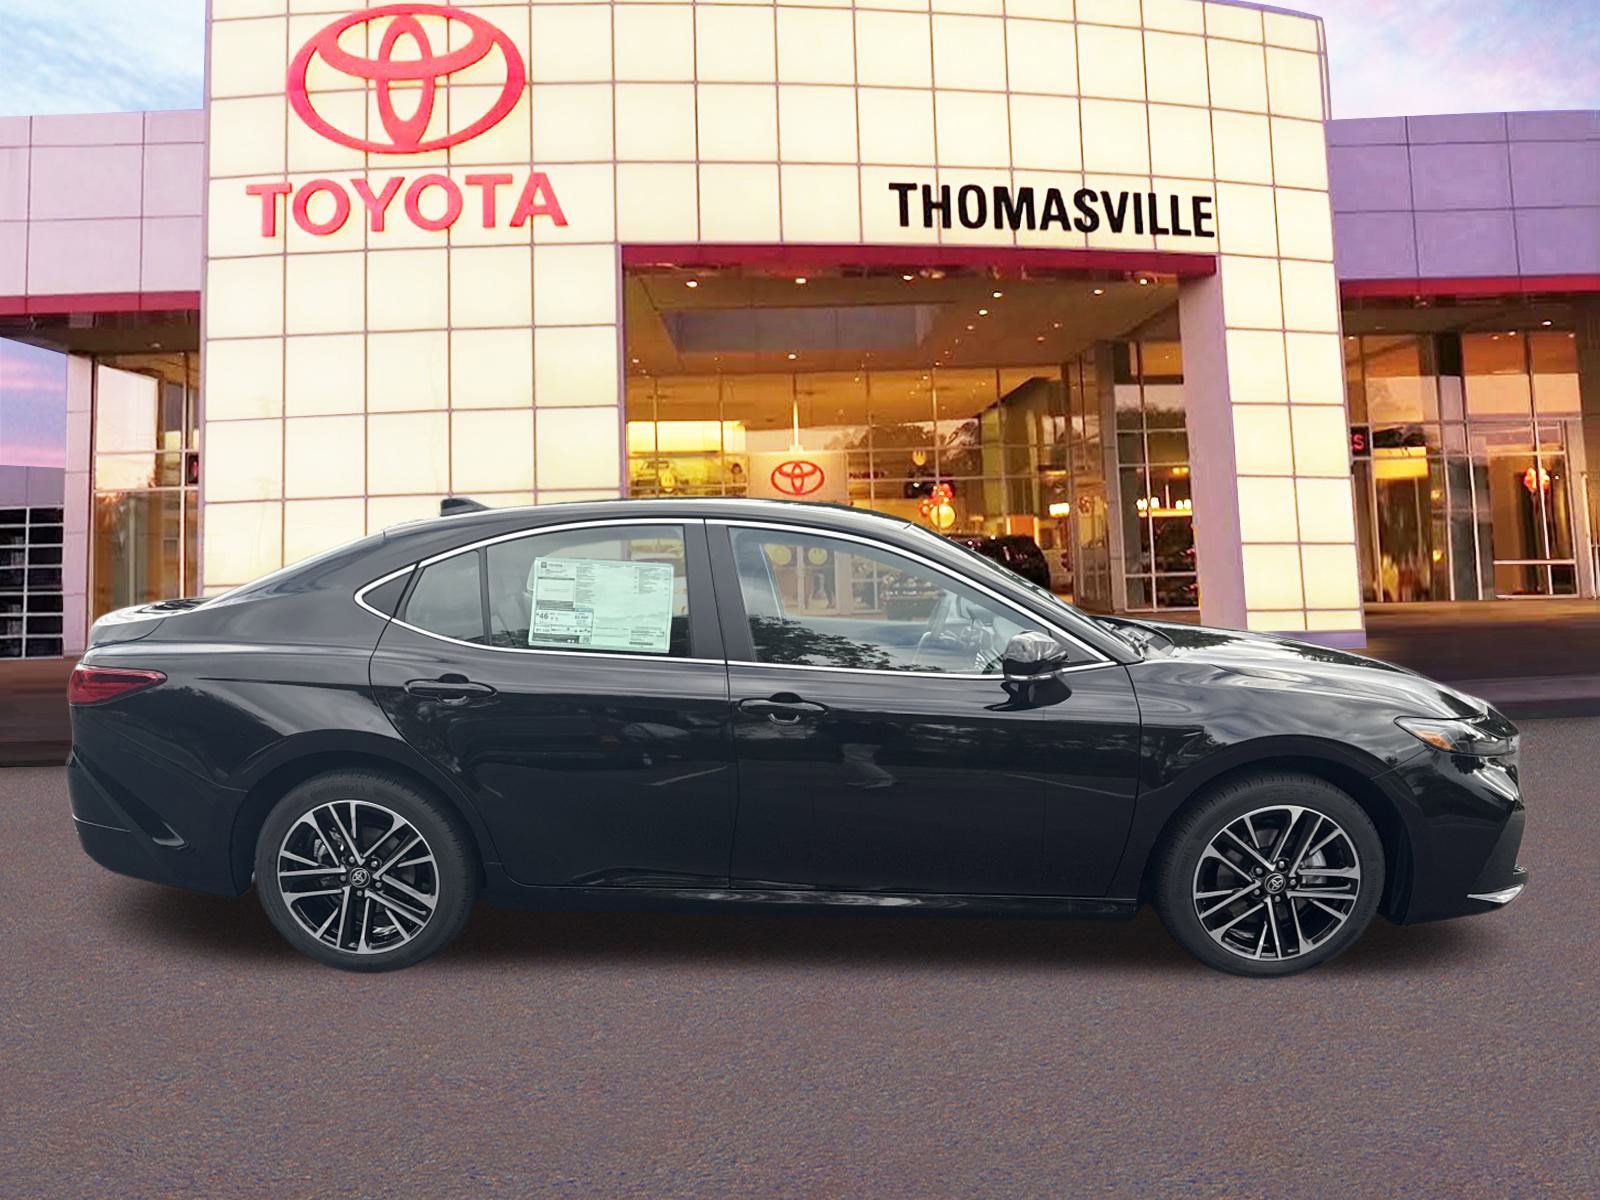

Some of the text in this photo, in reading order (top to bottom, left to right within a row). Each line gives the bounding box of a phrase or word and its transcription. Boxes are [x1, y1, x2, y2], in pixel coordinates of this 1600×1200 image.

[246, 172, 568, 237] TOYOTA
[888, 183, 1215, 237] THOMASVILLE
[1350, 433, 1365, 450] S
